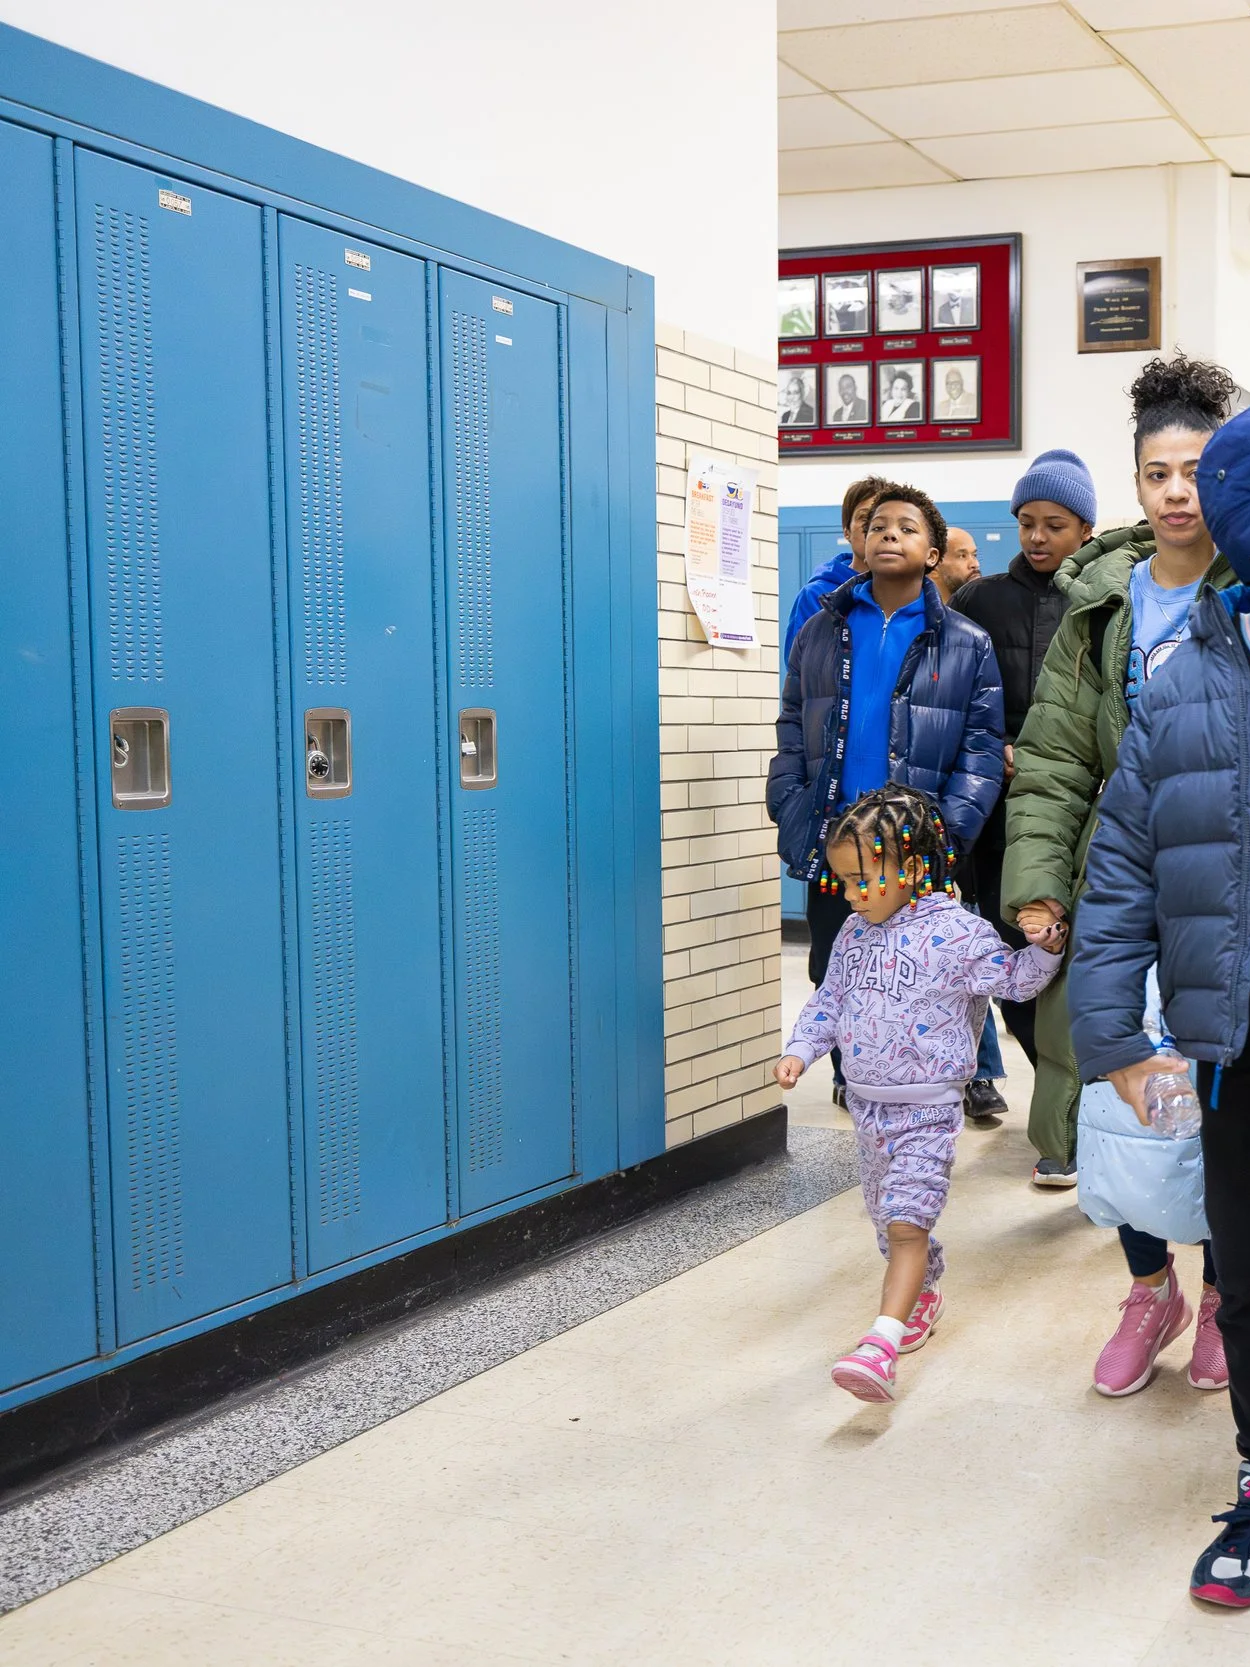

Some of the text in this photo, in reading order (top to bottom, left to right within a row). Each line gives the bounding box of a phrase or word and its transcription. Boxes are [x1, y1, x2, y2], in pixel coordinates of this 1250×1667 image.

[842, 658, 850, 680] POLO
[840, 699, 849, 720] POLO
[836, 738, 845, 760] POLO
[828, 778, 838, 800] POLO
[819, 819, 830, 840] POLO
[806, 858, 819, 879] POLO
[842, 944, 917, 1002] GAP
[909, 1107, 939, 1126] GAP
